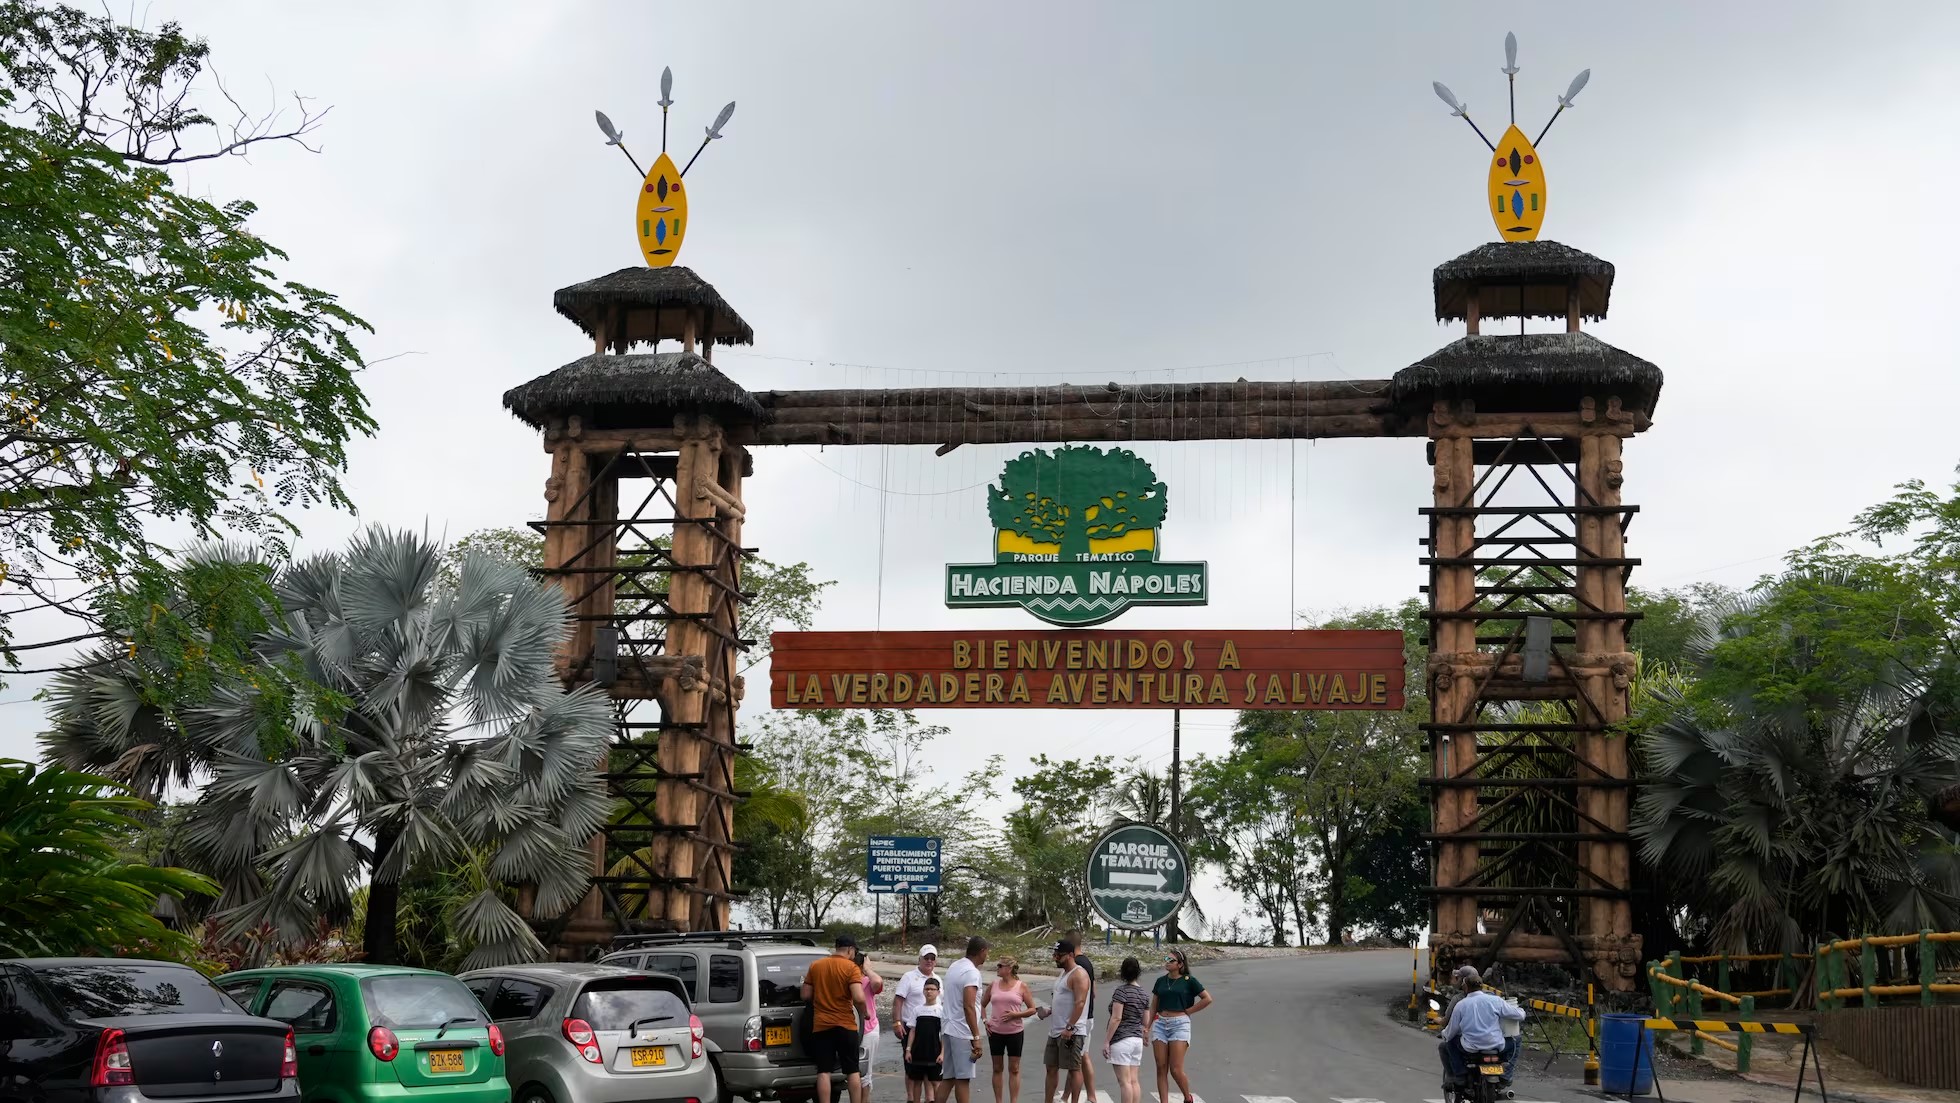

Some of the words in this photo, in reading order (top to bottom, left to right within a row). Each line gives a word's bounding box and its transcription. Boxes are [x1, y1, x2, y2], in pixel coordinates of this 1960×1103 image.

[1013, 553, 1059, 562] PARQUE
[1076, 553, 1135, 562] TEMATICO
[951, 574, 1078, 596] HACIENDA
[1089, 567, 1201, 594] NÁPOLES
[952, 639, 1195, 669] BIENVENIDOS
[1218, 640, 1241, 670] A
[786, 673, 824, 704] LA
[831, 673, 1031, 703] VERDADERA
[1046, 673, 1230, 704] AVENTURA
[1244, 672, 1388, 704] SALVAJE
[869, 838, 895, 846] INPEC
[872, 849, 937, 858] ESTABLECIMIENTO
[1108, 842, 1169, 857] PARQUE
[876, 857, 932, 865] PENITENCIARIO
[1100, 855, 1177, 870] TEMATICO
[903, 865, 936, 873] TRIUNFO
